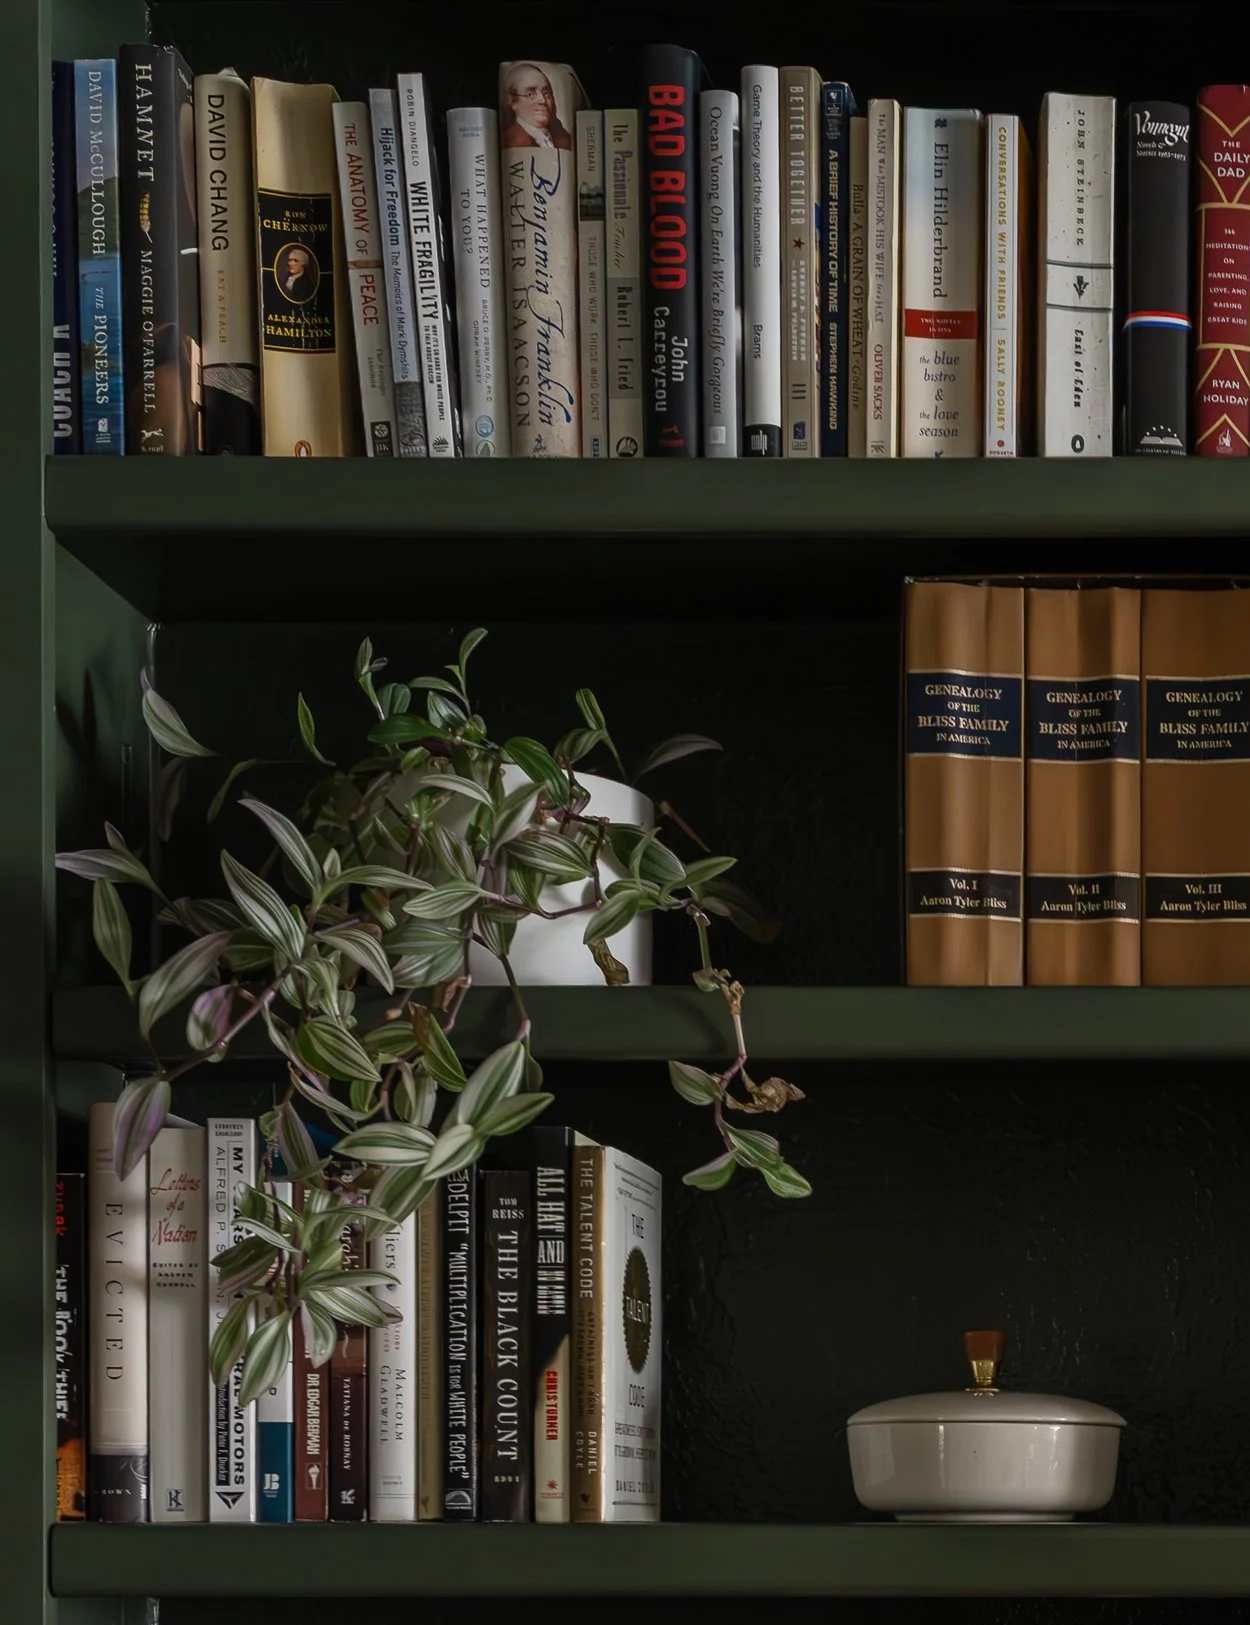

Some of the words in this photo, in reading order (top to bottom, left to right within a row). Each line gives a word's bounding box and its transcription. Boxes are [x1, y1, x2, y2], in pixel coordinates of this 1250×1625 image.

[88, 71, 102, 123] DAVID
[648, 85, 685, 157] BAD
[134, 64, 154, 182] HAMNET
[207, 94, 225, 161] DAVID
[345, 123, 357, 146] THE
[381, 127, 397, 167] Hijack
[709, 107, 721, 151] Ocean
[383, 169, 396, 187] for
[707, 154, 723, 200] Vuong
[933, 142, 948, 179] Elin
[210, 169, 229, 251] CHANG
[346, 153, 370, 233] ANATOMY
[410, 181, 431, 235] WHITE
[508, 161, 525, 269] WALTER
[710, 205, 723, 223] On
[263, 220, 328, 233] CHERNOW
[385, 190, 401, 246] Freedom
[649, 170, 687, 289] BLOOD
[933, 187, 948, 298] Hilderbrand
[356, 239, 369, 255] OF
[710, 229, 723, 265] Earth
[95, 287, 103, 309] THE
[140, 250, 153, 315] MAGGIE
[359, 275, 378, 326] PEACE
[415, 241, 438, 319] FRAGILITY
[711, 270, 724, 304] We're
[266, 327, 332, 339] HAMILTON
[708, 308, 724, 351] Briefly
[94, 315, 109, 404] PIONEERS
[141, 321, 156, 413] O'FARRELL
[511, 287, 531, 428] ISAACSON
[651, 306, 669, 412] Carreyrou
[670, 336, 688, 382] John
[709, 357, 725, 414] Gorgeous
[1165, 690, 1243, 703] GENEALOGY
[1188, 709, 1200, 718] OF
[1202, 708, 1221, 718] THE
[1160, 721, 1197, 735] BLISS
[1200, 721, 1249, 735] FAMILY
[1177, 740, 1187, 749] IN
[1189, 739, 1232, 749] AMERICA
[1160, 900, 1191, 912] Aaron
[1194, 900, 1220, 913] Tyler
[1223, 900, 1247, 911] Bliss
[1185, 883, 1205, 895] Vol.
[1208, 883, 1221, 894] III
[579, 1159, 593, 1188] THE
[447, 1184, 468, 1234] DELPIT
[579, 1195, 593, 1253] TALENT
[497, 1231, 518, 1279] THE
[579, 1258, 593, 1298] CODE
[105, 1203, 123, 1380] EVICTED
[496, 1291, 518, 1367] BLACK
[495, 1379, 518, 1461] COUNT
